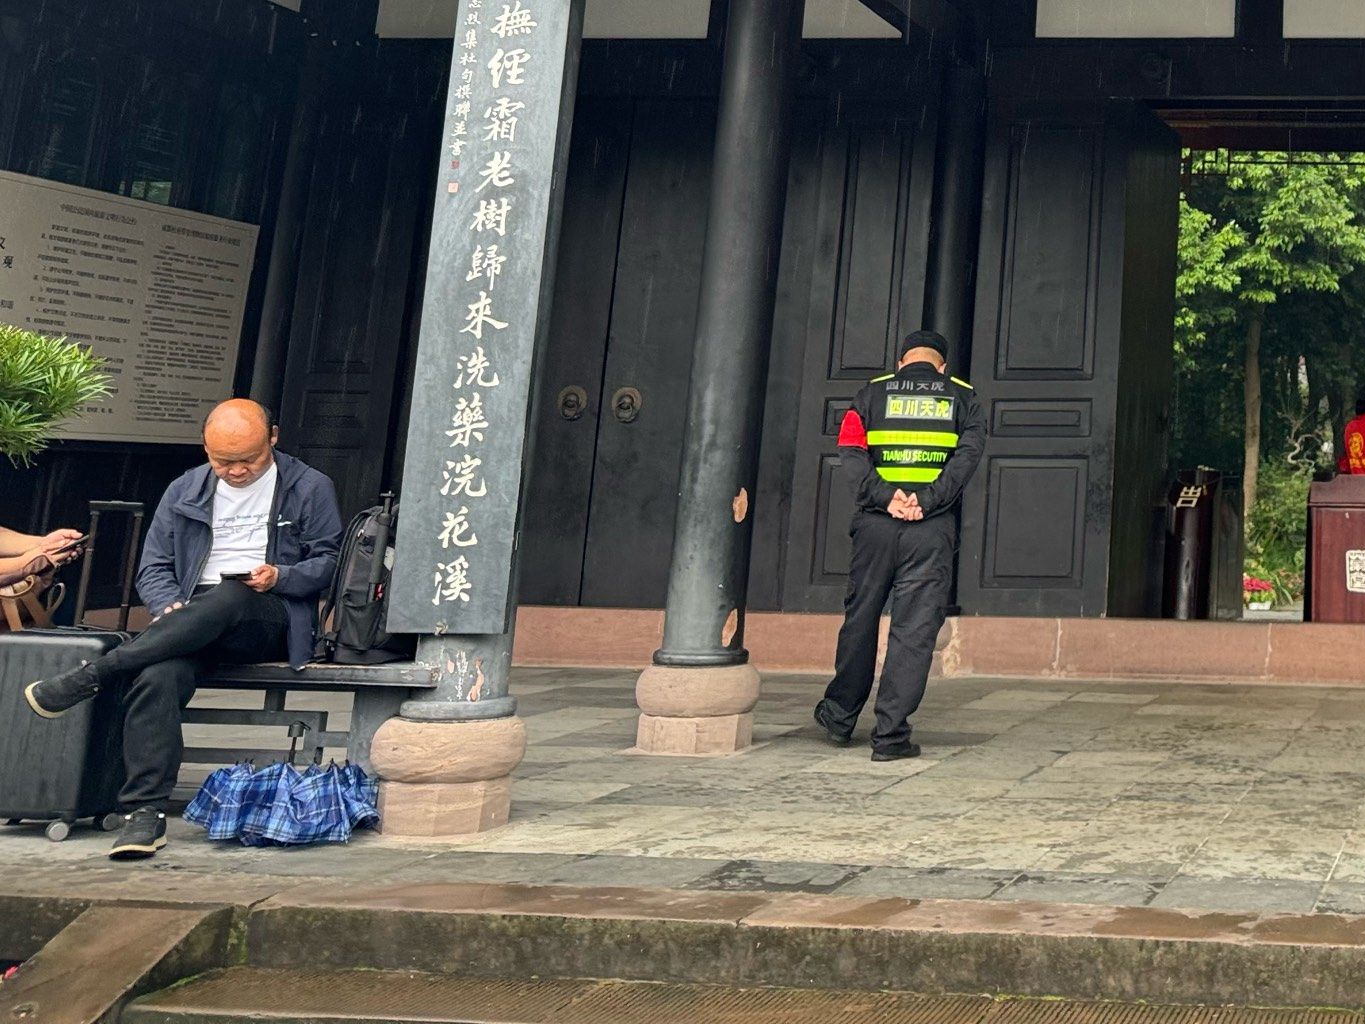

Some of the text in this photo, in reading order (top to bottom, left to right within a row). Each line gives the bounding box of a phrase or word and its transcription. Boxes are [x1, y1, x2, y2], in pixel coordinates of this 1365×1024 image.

[889, 399, 950, 418] 四川天虎
[883, 450, 911, 462] TIANHU
